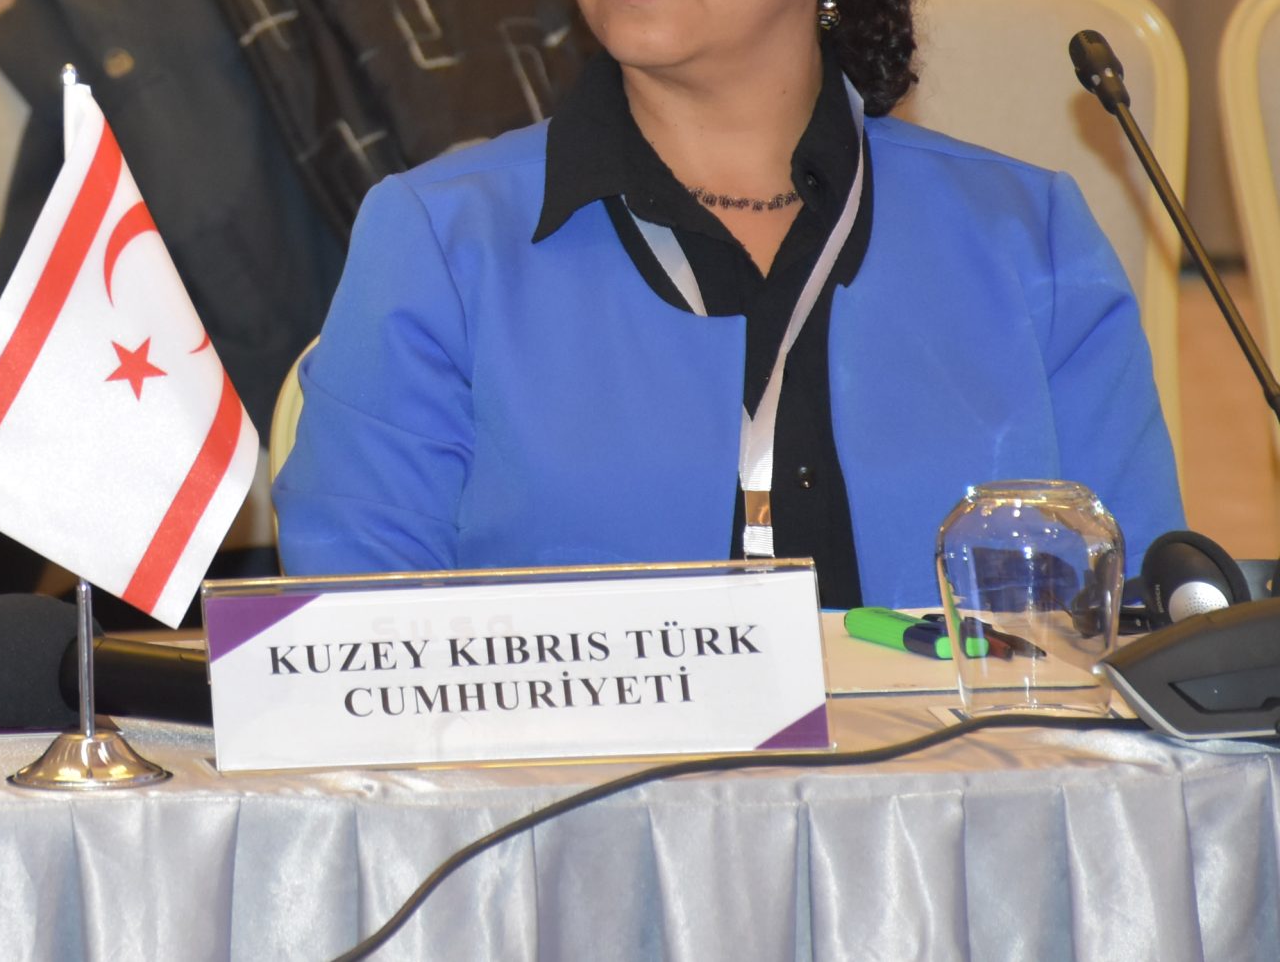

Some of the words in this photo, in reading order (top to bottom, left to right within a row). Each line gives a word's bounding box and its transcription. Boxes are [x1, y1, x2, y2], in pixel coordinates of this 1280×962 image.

[268, 639, 430, 675] KUZEY
[448, 632, 611, 668] KIBRIS
[625, 620, 762, 659] TÜRK
[344, 665, 693, 718] CUMHURİYETİ
